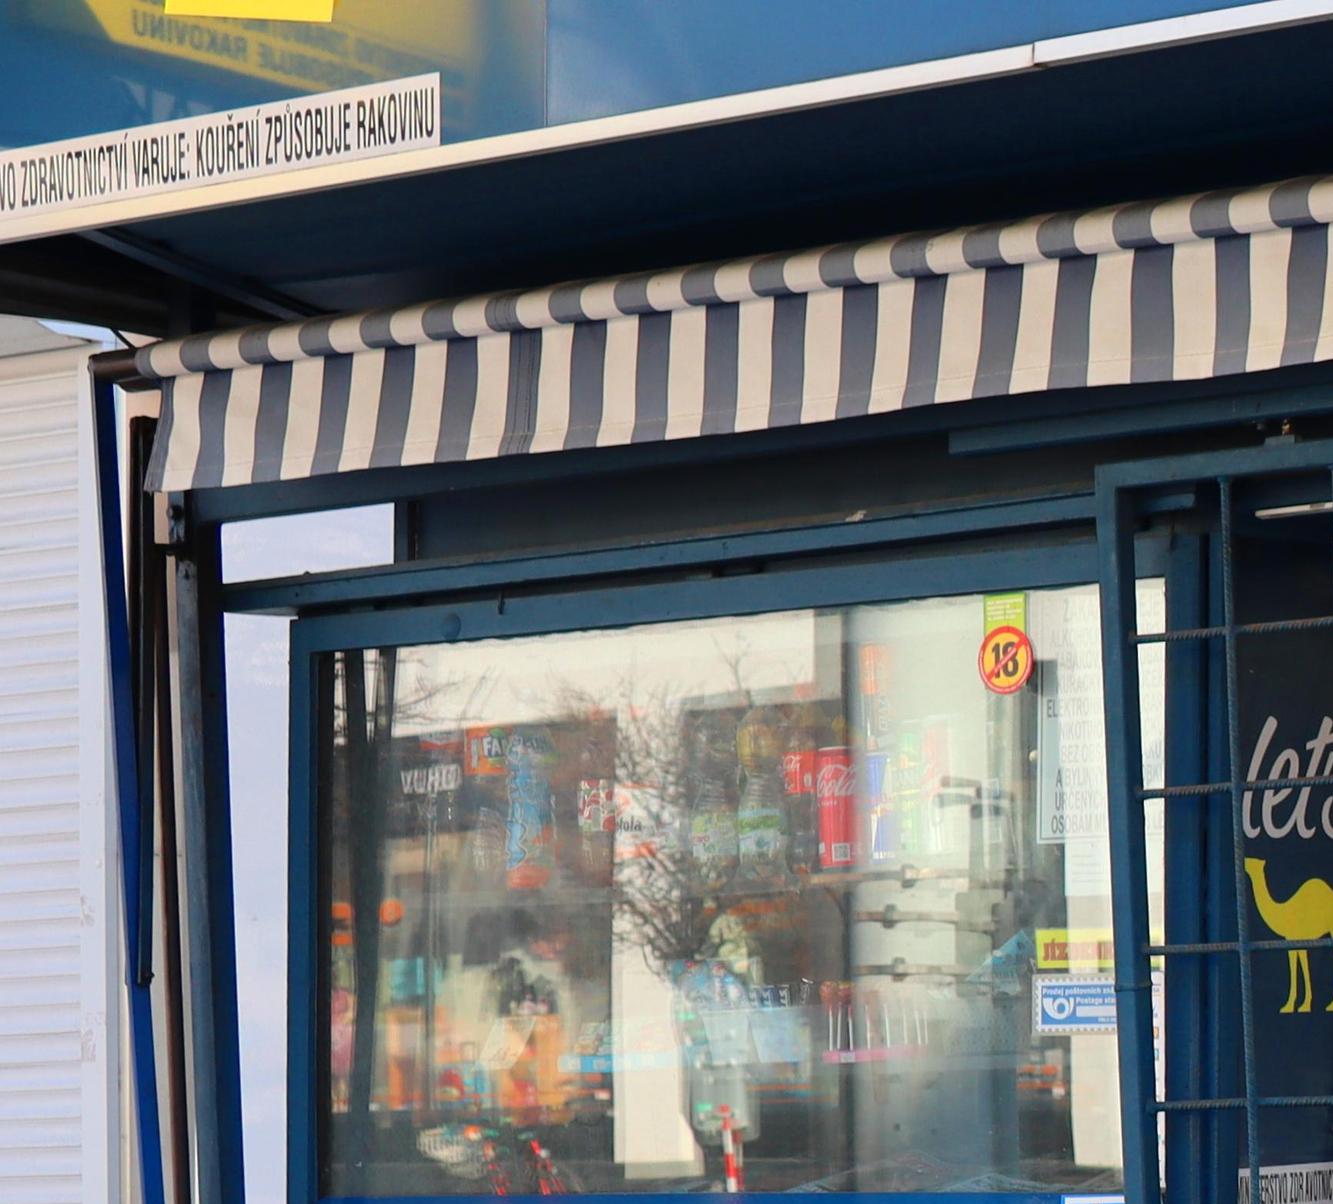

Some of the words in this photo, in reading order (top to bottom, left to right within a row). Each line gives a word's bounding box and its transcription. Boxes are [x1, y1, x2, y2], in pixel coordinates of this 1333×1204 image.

[20, 132, 128, 207] ZDRAVOTNICTVÍ
[132, 132, 190, 188] VARUJE:
[196, 109, 260, 178] KOUŘENÍ
[265, 103, 351, 165] ZPŮSOBUJE
[357, 87, 435, 149] RAKOVINU
